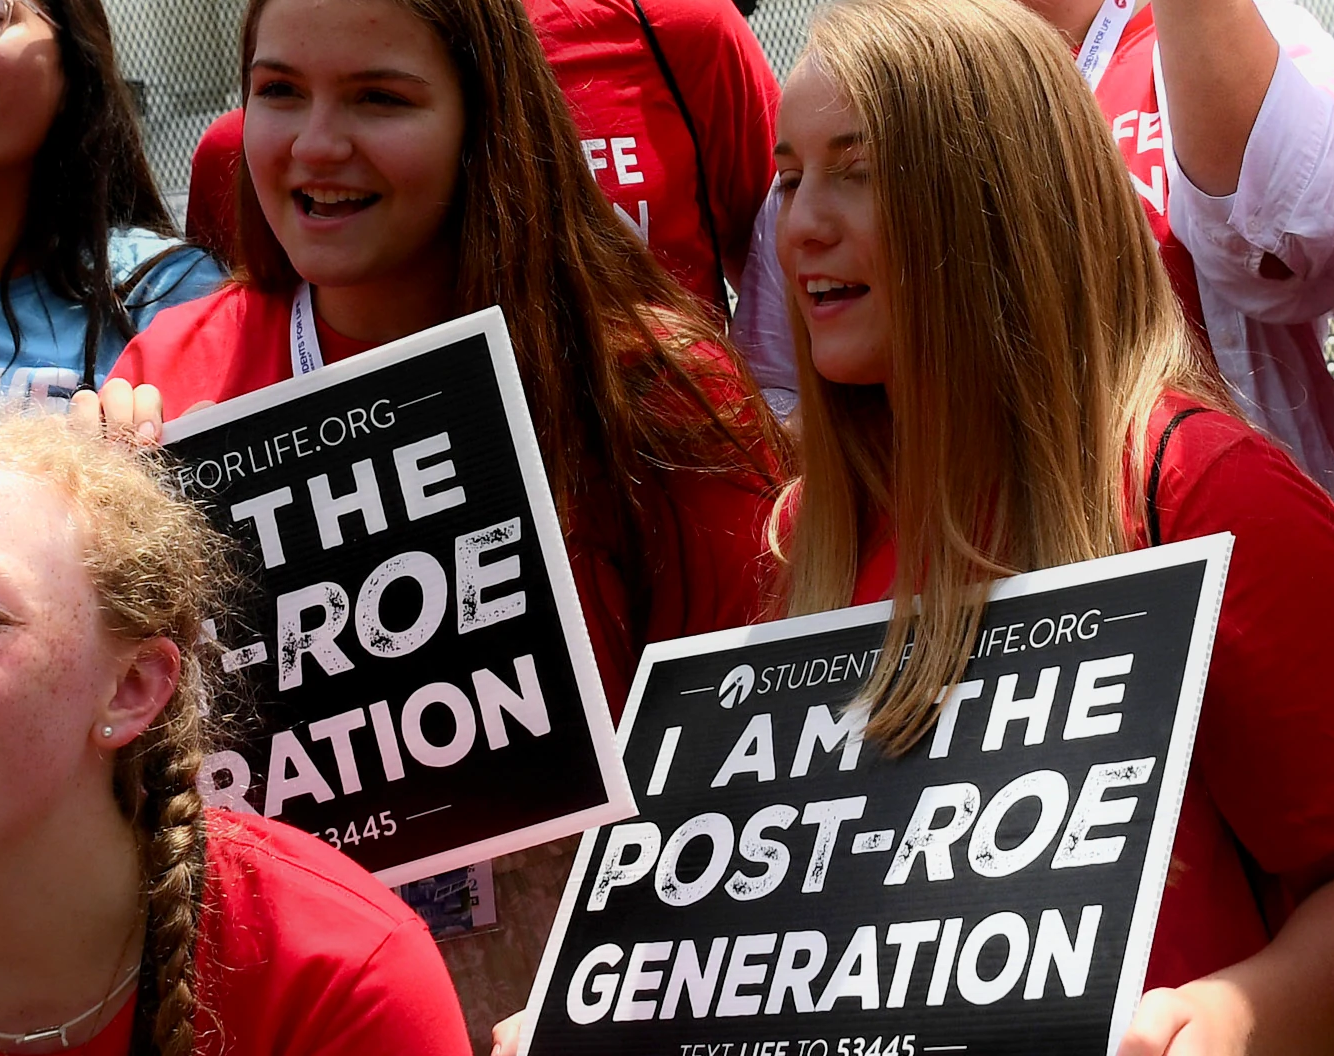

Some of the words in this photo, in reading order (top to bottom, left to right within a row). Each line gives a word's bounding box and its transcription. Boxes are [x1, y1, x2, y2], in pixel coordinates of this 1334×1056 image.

[177, 399, 397, 498] FORLIFE.ORG
[230, 431, 467, 570] THE
[646, 726, 682, 797] I
[710, 702, 871, 789] AM
[929, 653, 1135, 760] THE
[313, 810, 397, 851] 3445
[587, 757, 1157, 911] POST-ROE
[566, 904, 1104, 1025] GENERATION
[837, 1034, 916, 1056] 53445
